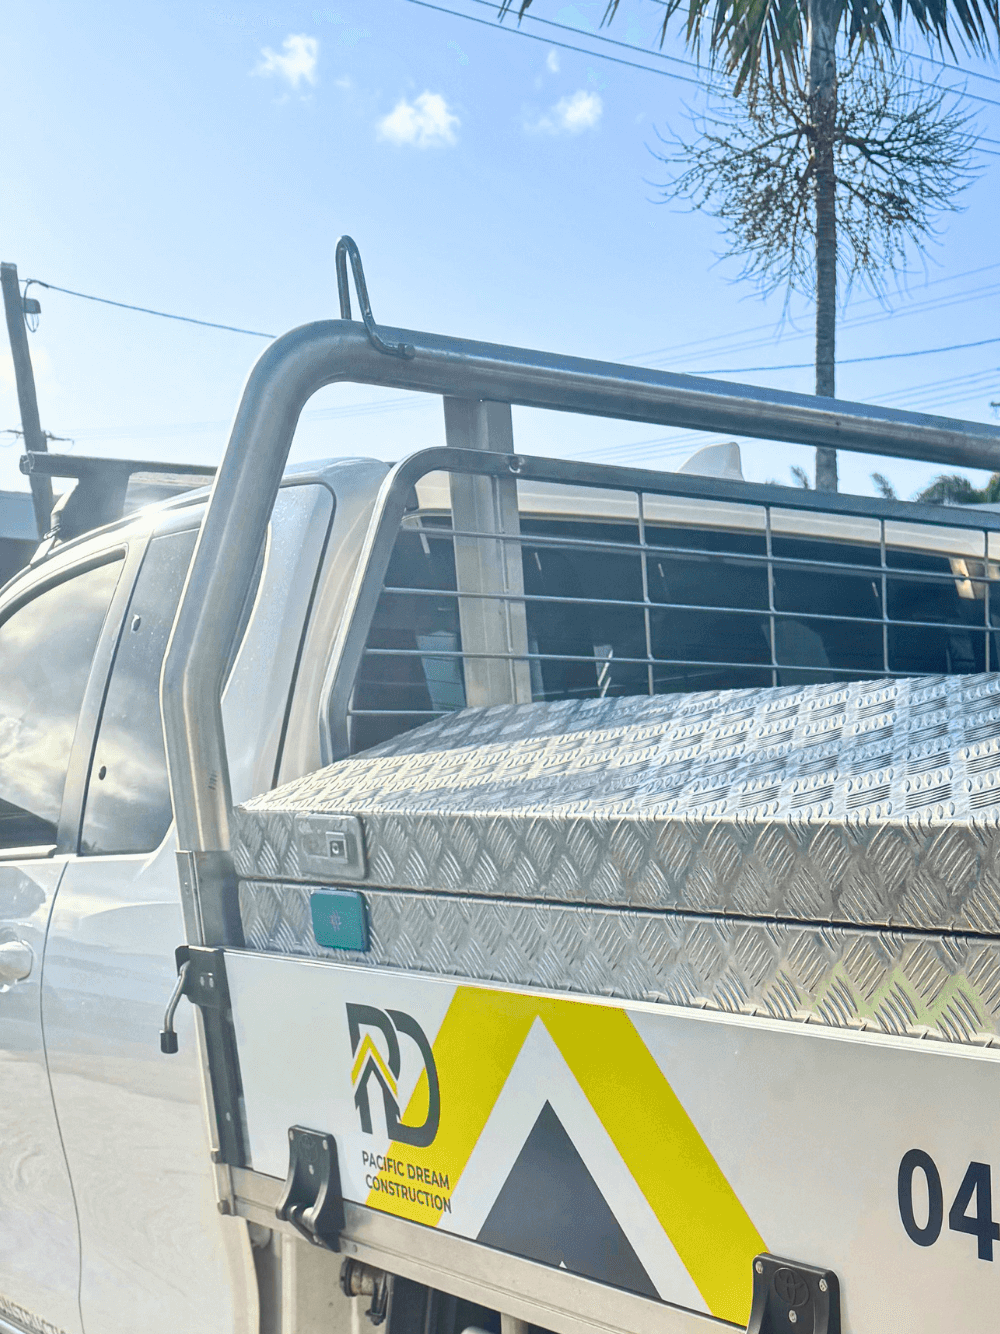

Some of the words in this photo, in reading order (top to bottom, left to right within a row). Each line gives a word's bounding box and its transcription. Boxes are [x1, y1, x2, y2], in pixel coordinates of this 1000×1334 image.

[362, 1150, 405, 1177] PACIFIC
[406, 1163, 450, 1191] DREAM
[365, 1174, 452, 1214] CONSTRUCTION
